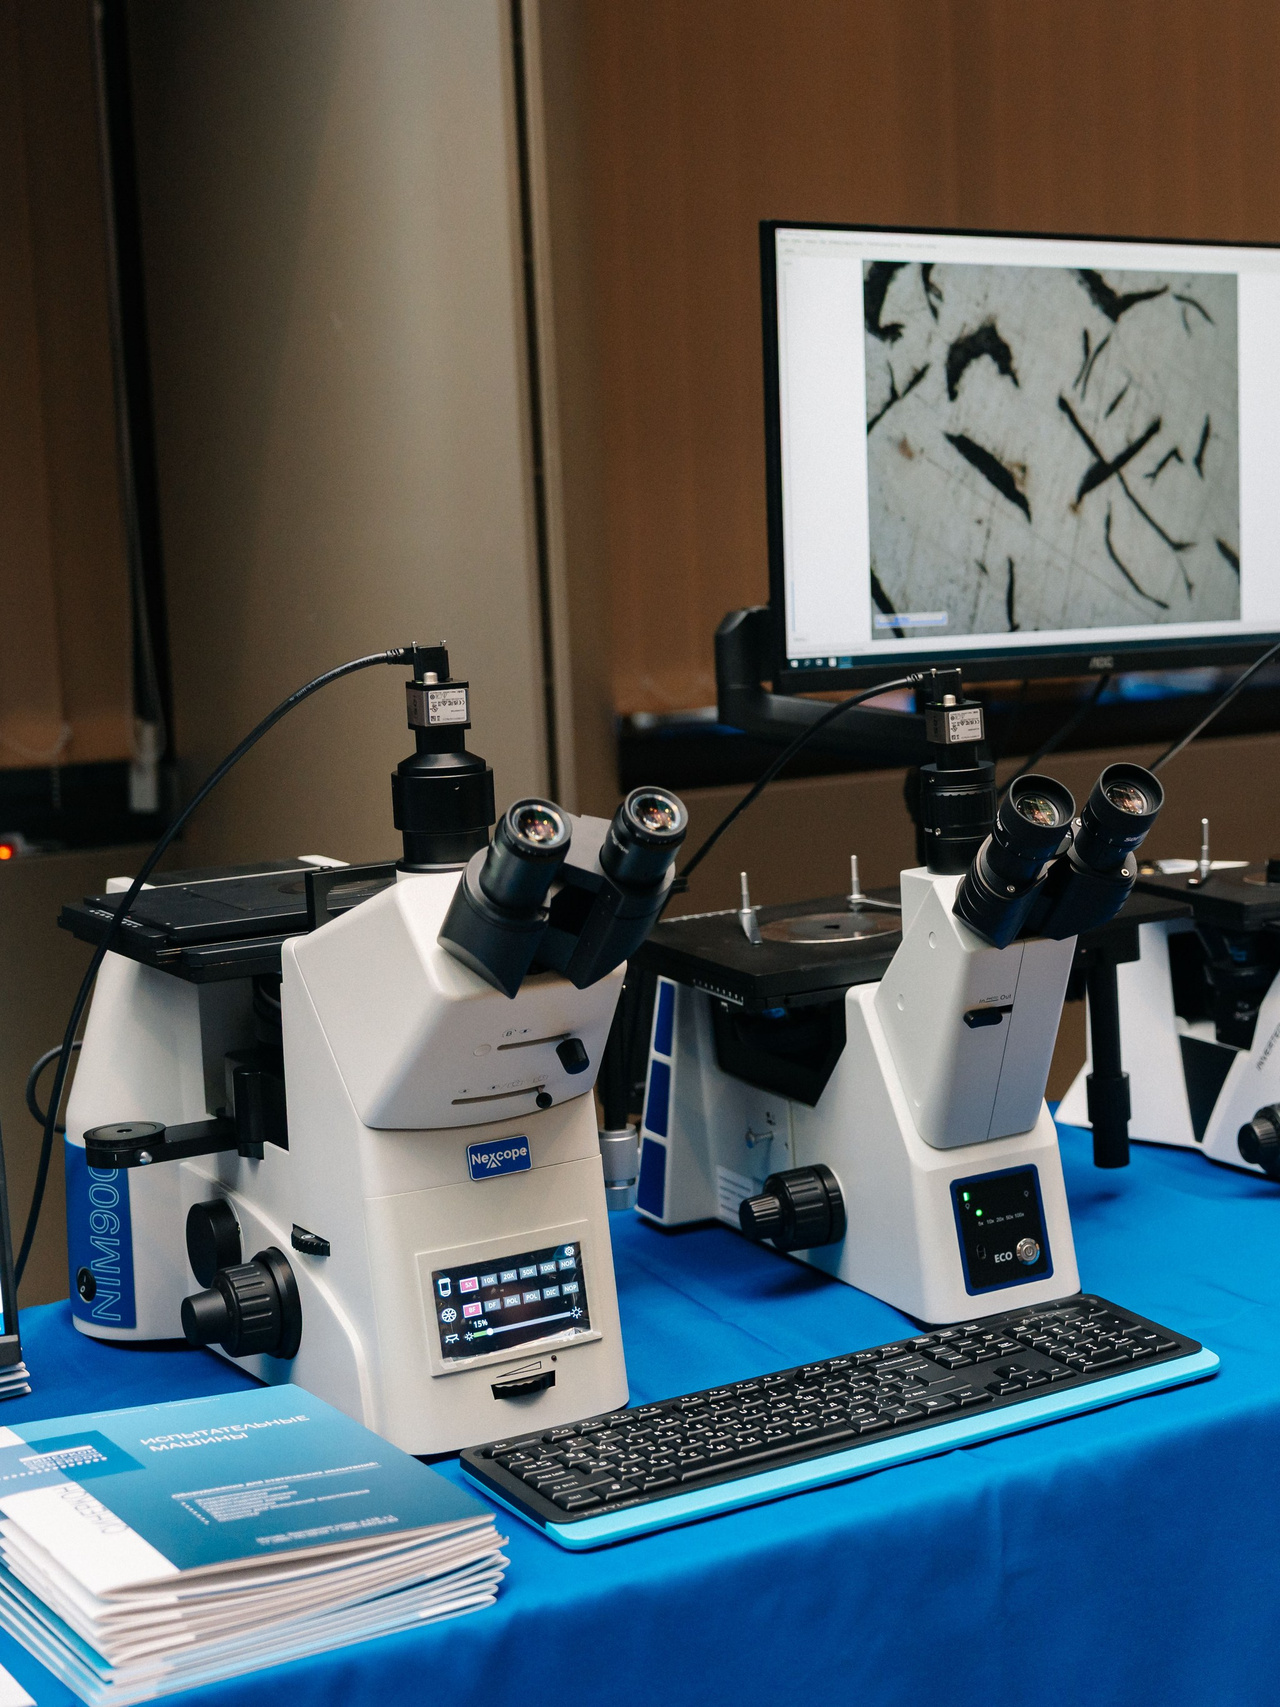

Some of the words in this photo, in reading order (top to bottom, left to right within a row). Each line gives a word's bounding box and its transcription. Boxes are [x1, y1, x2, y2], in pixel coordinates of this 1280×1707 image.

[471, 1146, 528, 1170] Nexcope
[994, 1251, 1013, 1264] ECO
[483, 1276, 495, 1284] 10X
[503, 1272, 515, 1280] 20X
[522, 1268, 534, 1276] 50X
[540, 1264, 556, 1272] 100X
[560, 1260, 574, 1268] NOP
[488, 1302, 497, 1310] DF
[506, 1297, 519, 1305] POL
[526, 1292, 538, 1300] POL
[545, 1288, 557, 1296] DIC
[564, 1284, 578, 1292] NOP
[473, 1319, 488, 1328] 15%
[140, 1414, 310, 1446] ИСПЫТАТЕЛЬНЫЕ
[149, 1432, 249, 1452] МАШИНЫ
